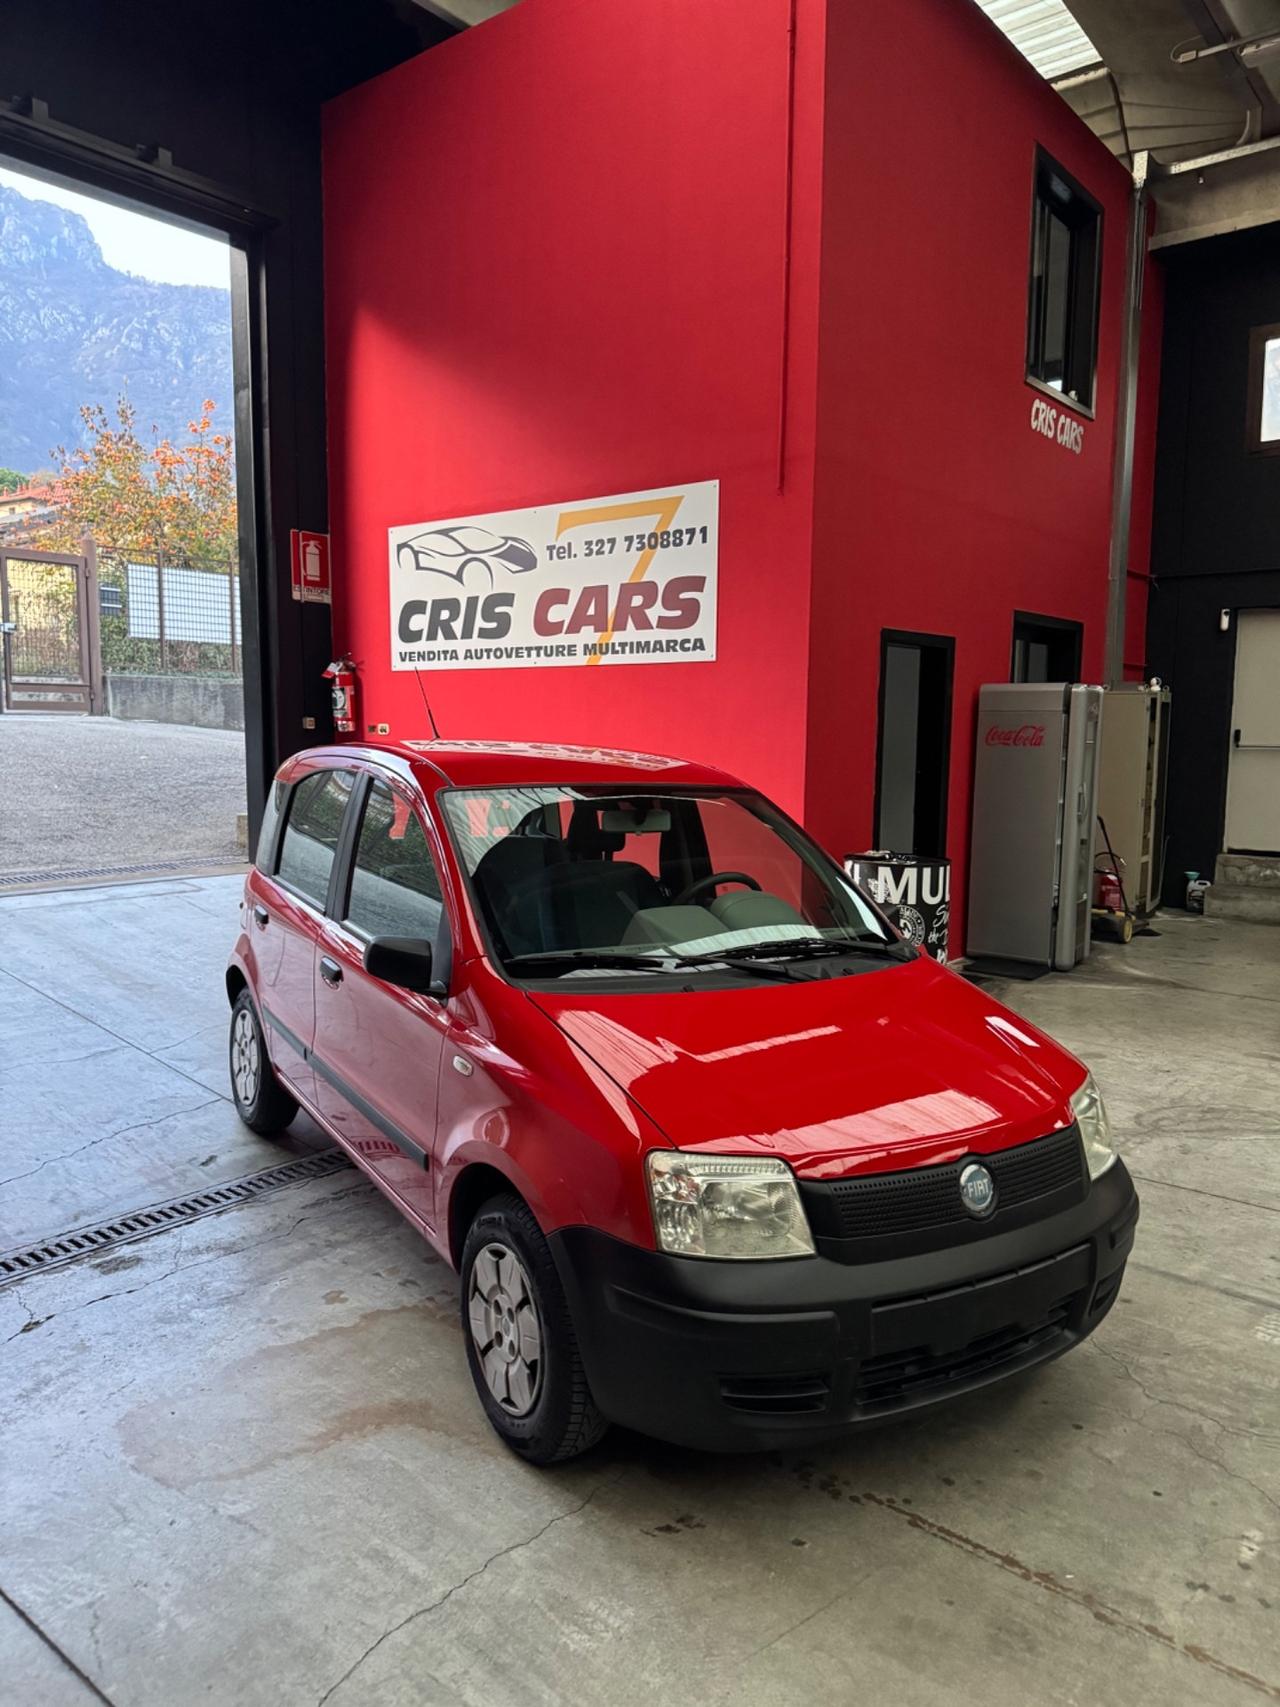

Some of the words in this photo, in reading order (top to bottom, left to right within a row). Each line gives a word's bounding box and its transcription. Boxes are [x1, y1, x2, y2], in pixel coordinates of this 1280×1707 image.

[1030, 398, 1057, 439] CRIS
[1057, 414, 1084, 455] CARS
[546, 542, 577, 561] Tel.
[584, 537, 617, 557] 327
[624, 525, 708, 552] 7308871
[397, 592, 515, 644] CRIS
[533, 575, 707, 637] CARS
[399, 649, 459, 662] VENDITA
[463, 644, 577, 661] AUTOVETTURE
[583, 637, 706, 657] MULTIMARCA
[967, 1178, 989, 1198] FIAT
